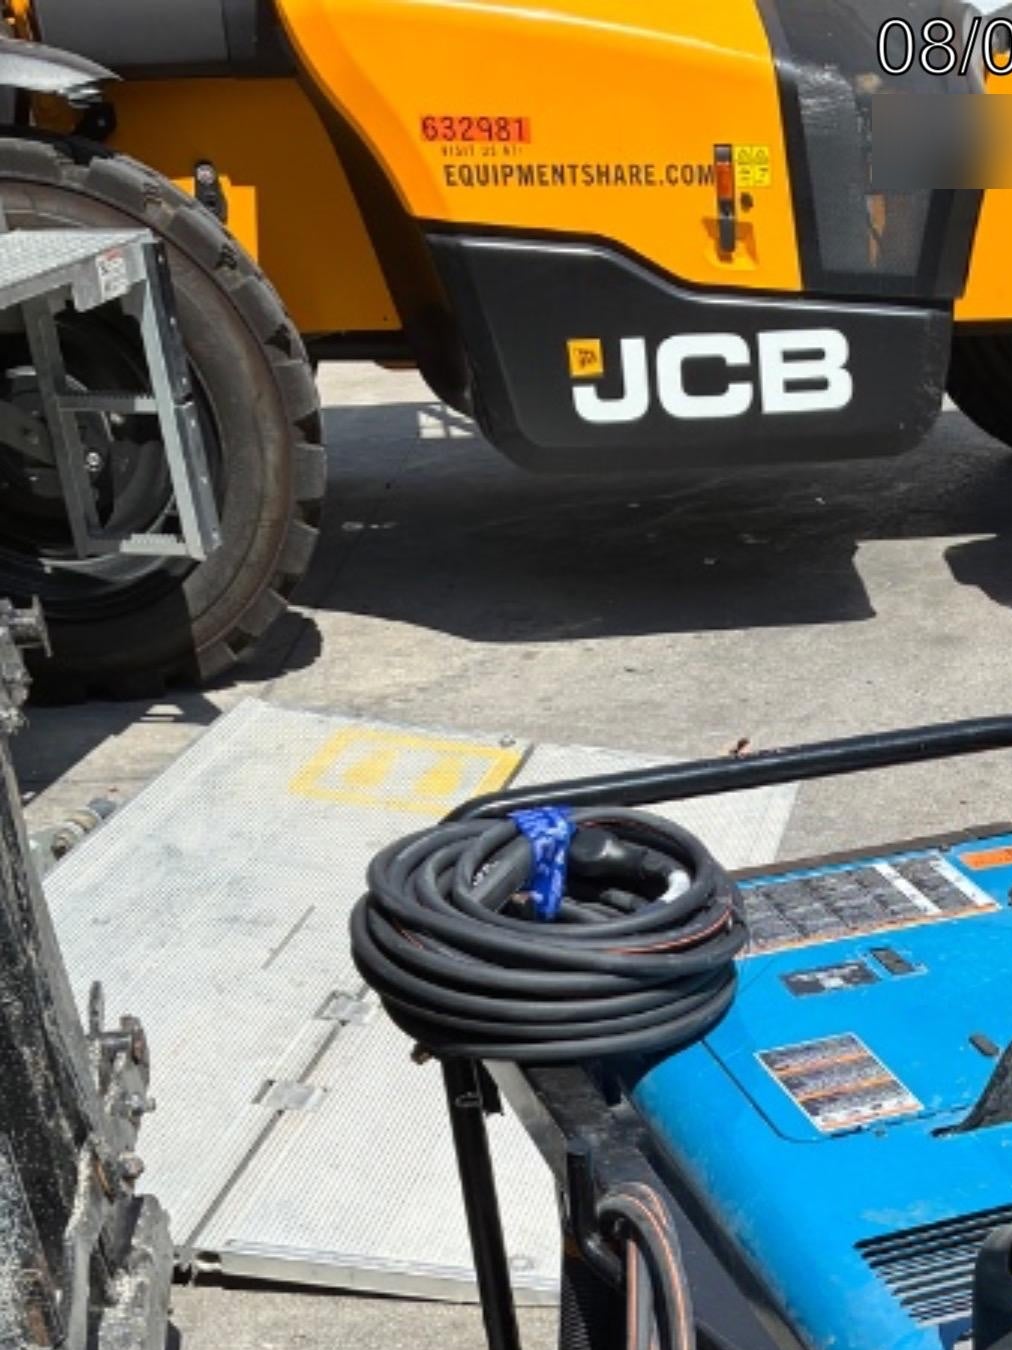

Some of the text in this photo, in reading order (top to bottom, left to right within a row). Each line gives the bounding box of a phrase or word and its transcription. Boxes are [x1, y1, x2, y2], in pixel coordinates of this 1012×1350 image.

[421, 115, 524, 142] 632981
[443, 163, 716, 188] EQUIPMENTSHARE.COM
[571, 328, 854, 424] JCB
